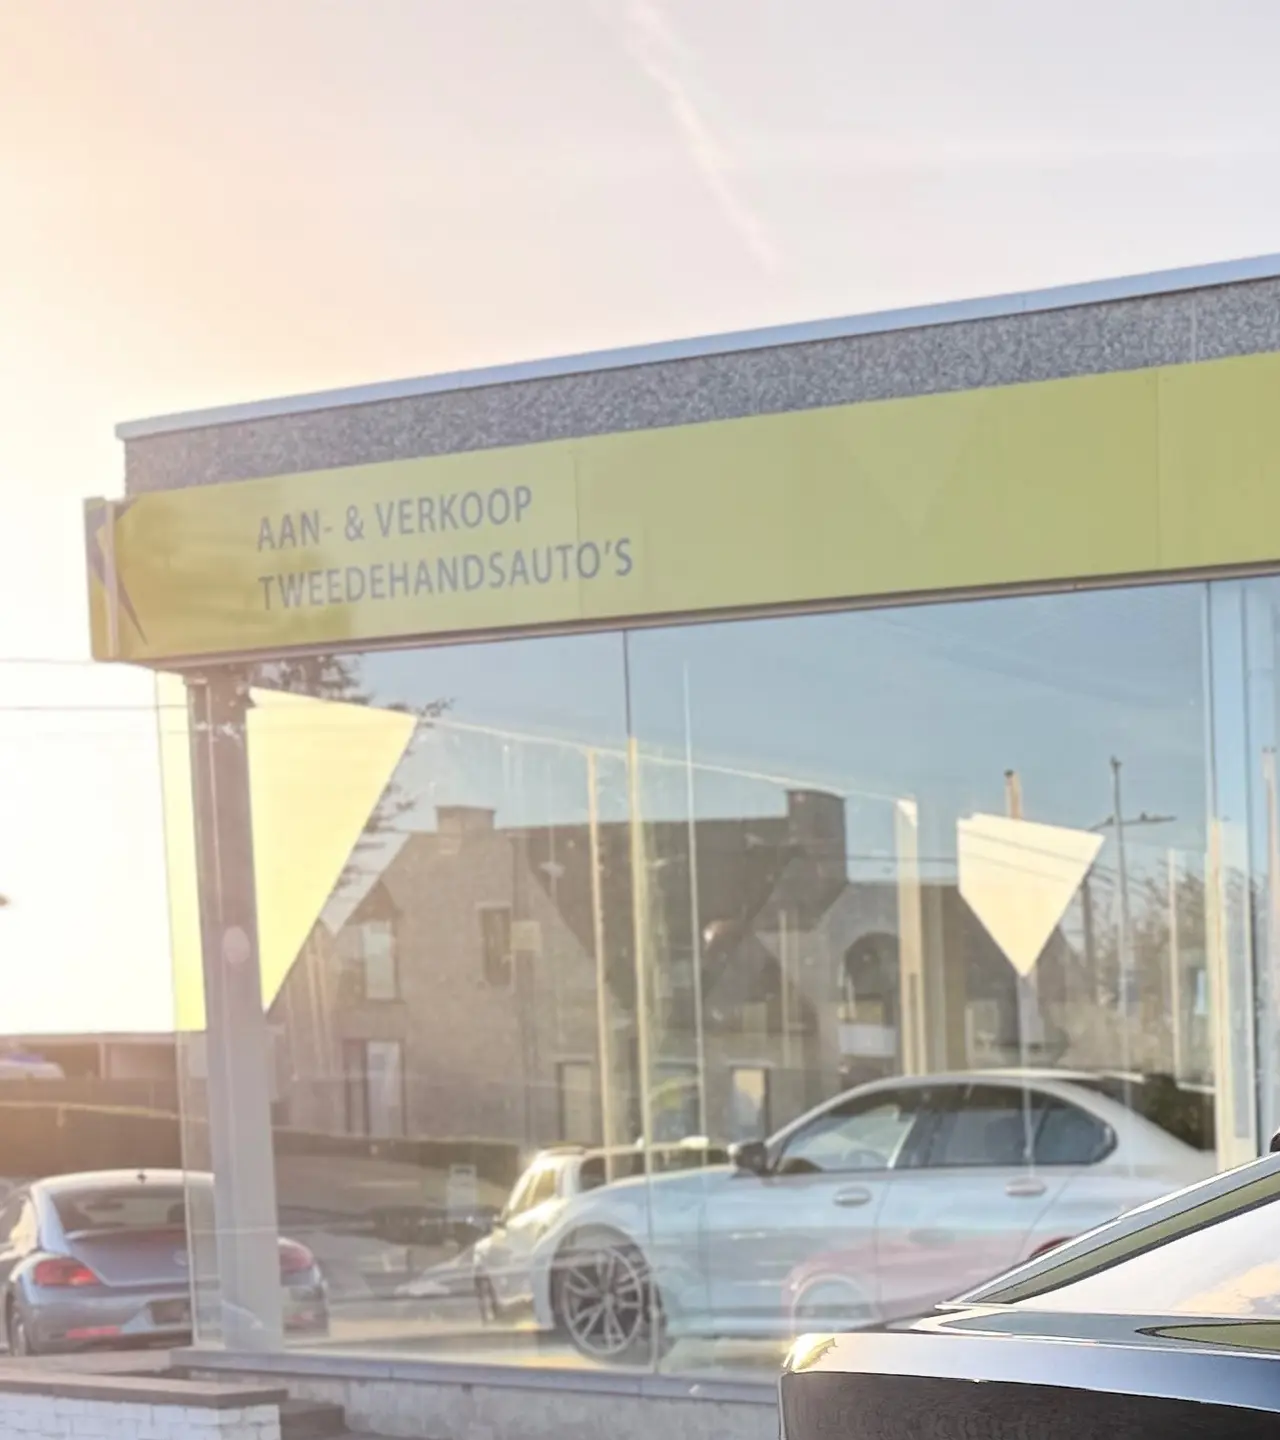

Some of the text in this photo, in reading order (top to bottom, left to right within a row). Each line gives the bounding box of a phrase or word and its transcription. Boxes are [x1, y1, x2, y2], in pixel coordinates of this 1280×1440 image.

[257, 485, 532, 552] AAN- & VERKOOP
[257, 537, 634, 611] TWEEDEHANDSAUTO'S
